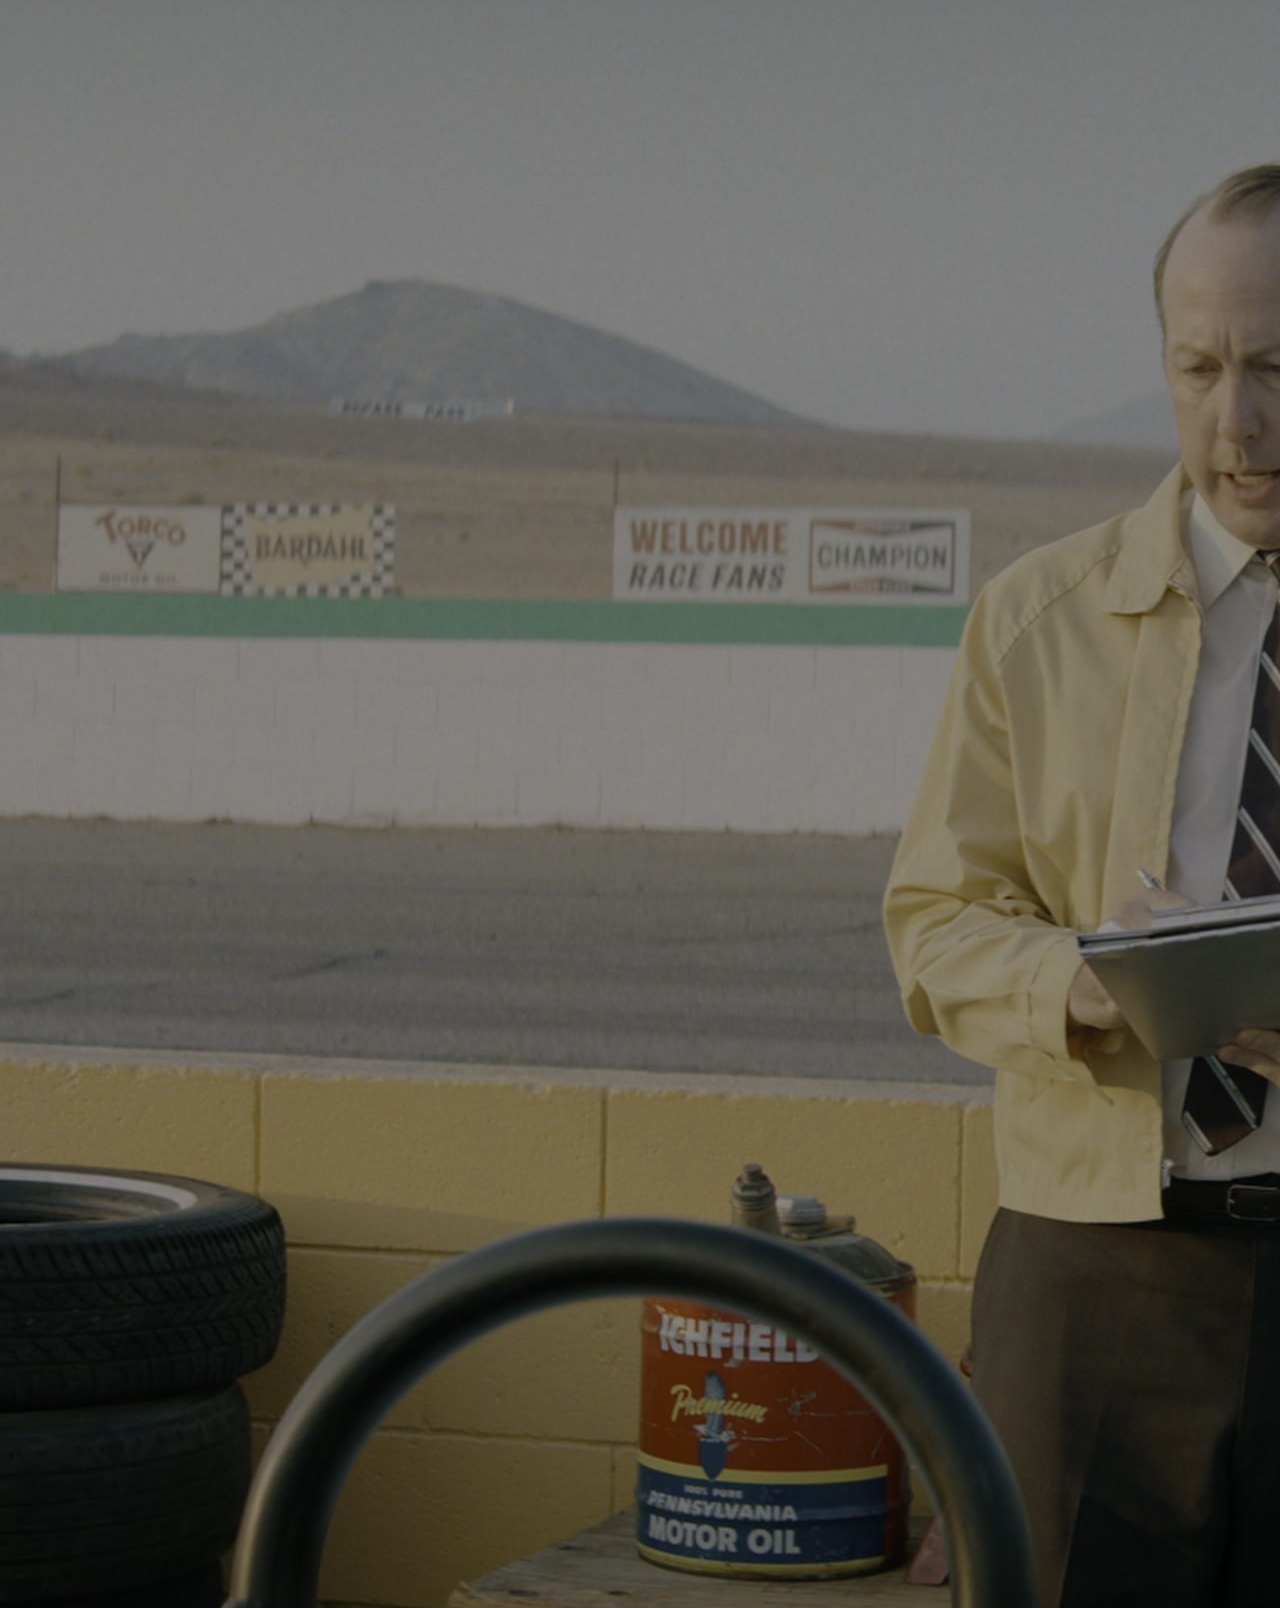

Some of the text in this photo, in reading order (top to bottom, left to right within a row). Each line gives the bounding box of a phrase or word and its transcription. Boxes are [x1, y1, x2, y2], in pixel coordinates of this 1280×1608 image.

[255, 533, 368, 563] BARDAHL
[630, 520, 788, 554] WELCOME
[818, 542, 947, 570] CHAMPION
[628, 562, 786, 592] RACE FANS
[670, 1384, 768, 1423] Premium
[647, 1490, 798, 1522] PENNSYLVANIA
[648, 1514, 801, 1555] MOTOR OIL
